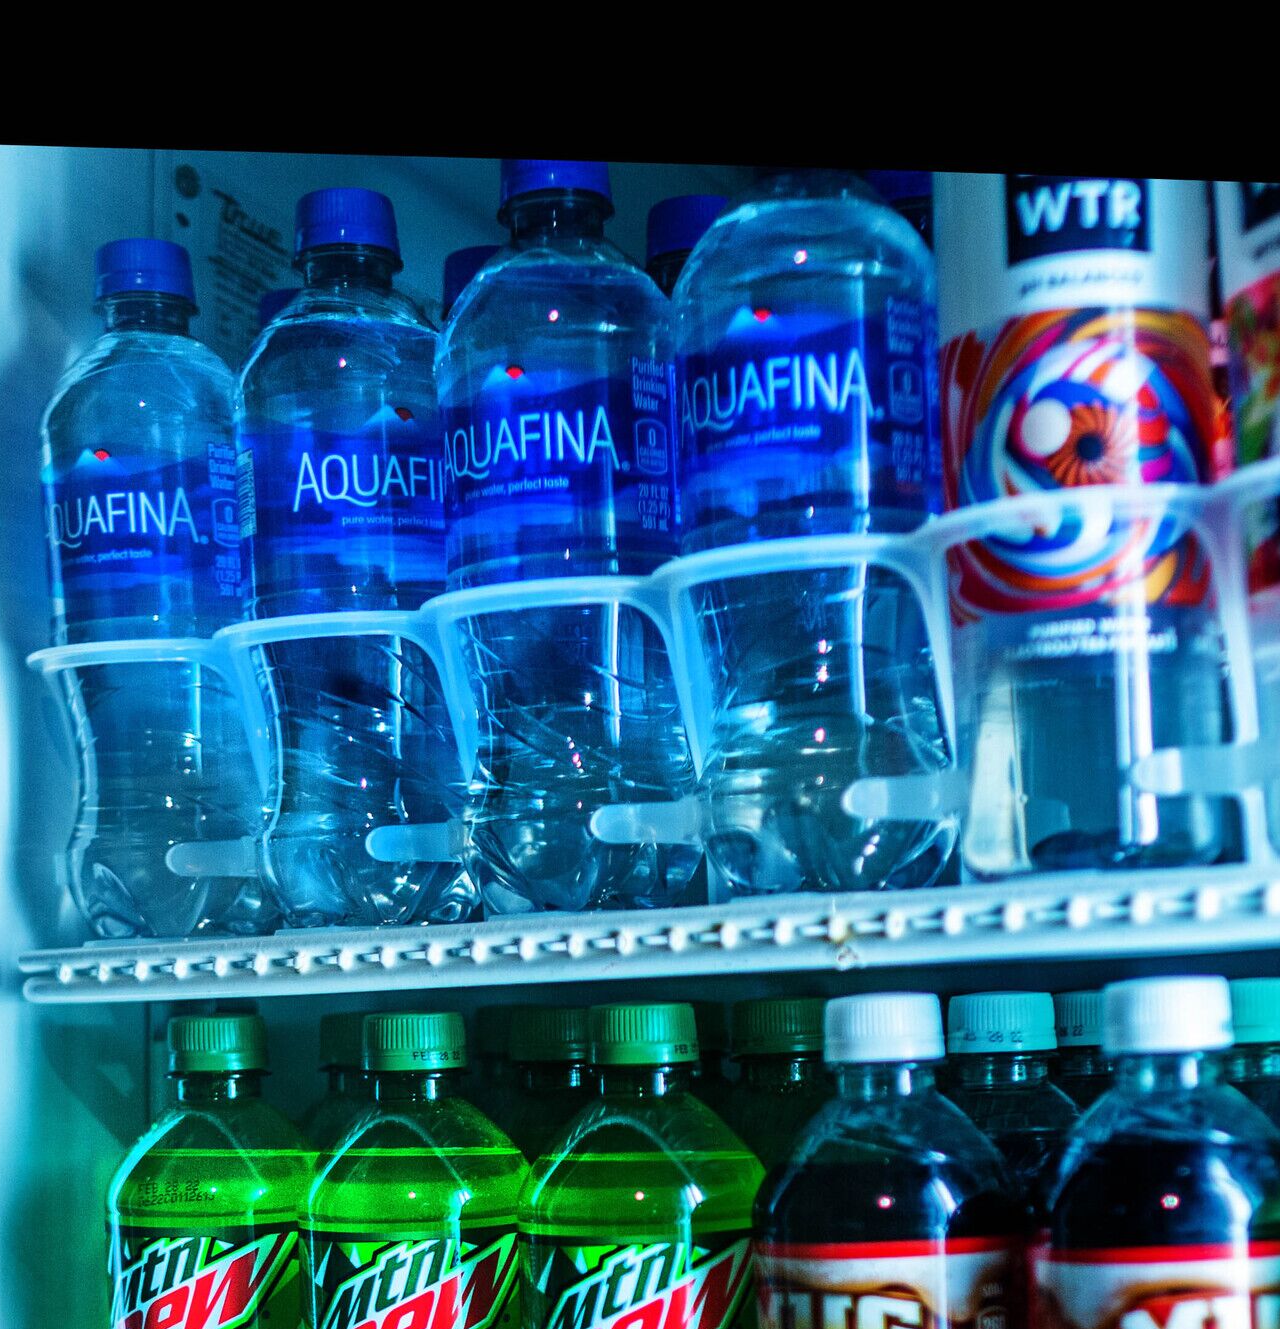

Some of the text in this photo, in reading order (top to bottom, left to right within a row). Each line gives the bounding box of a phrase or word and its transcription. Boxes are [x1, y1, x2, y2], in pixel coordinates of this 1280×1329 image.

[1016, 179, 1142, 237] WTR
[681, 347, 877, 450] AQUAFINA
[444, 405, 621, 496] AQUAFINA
